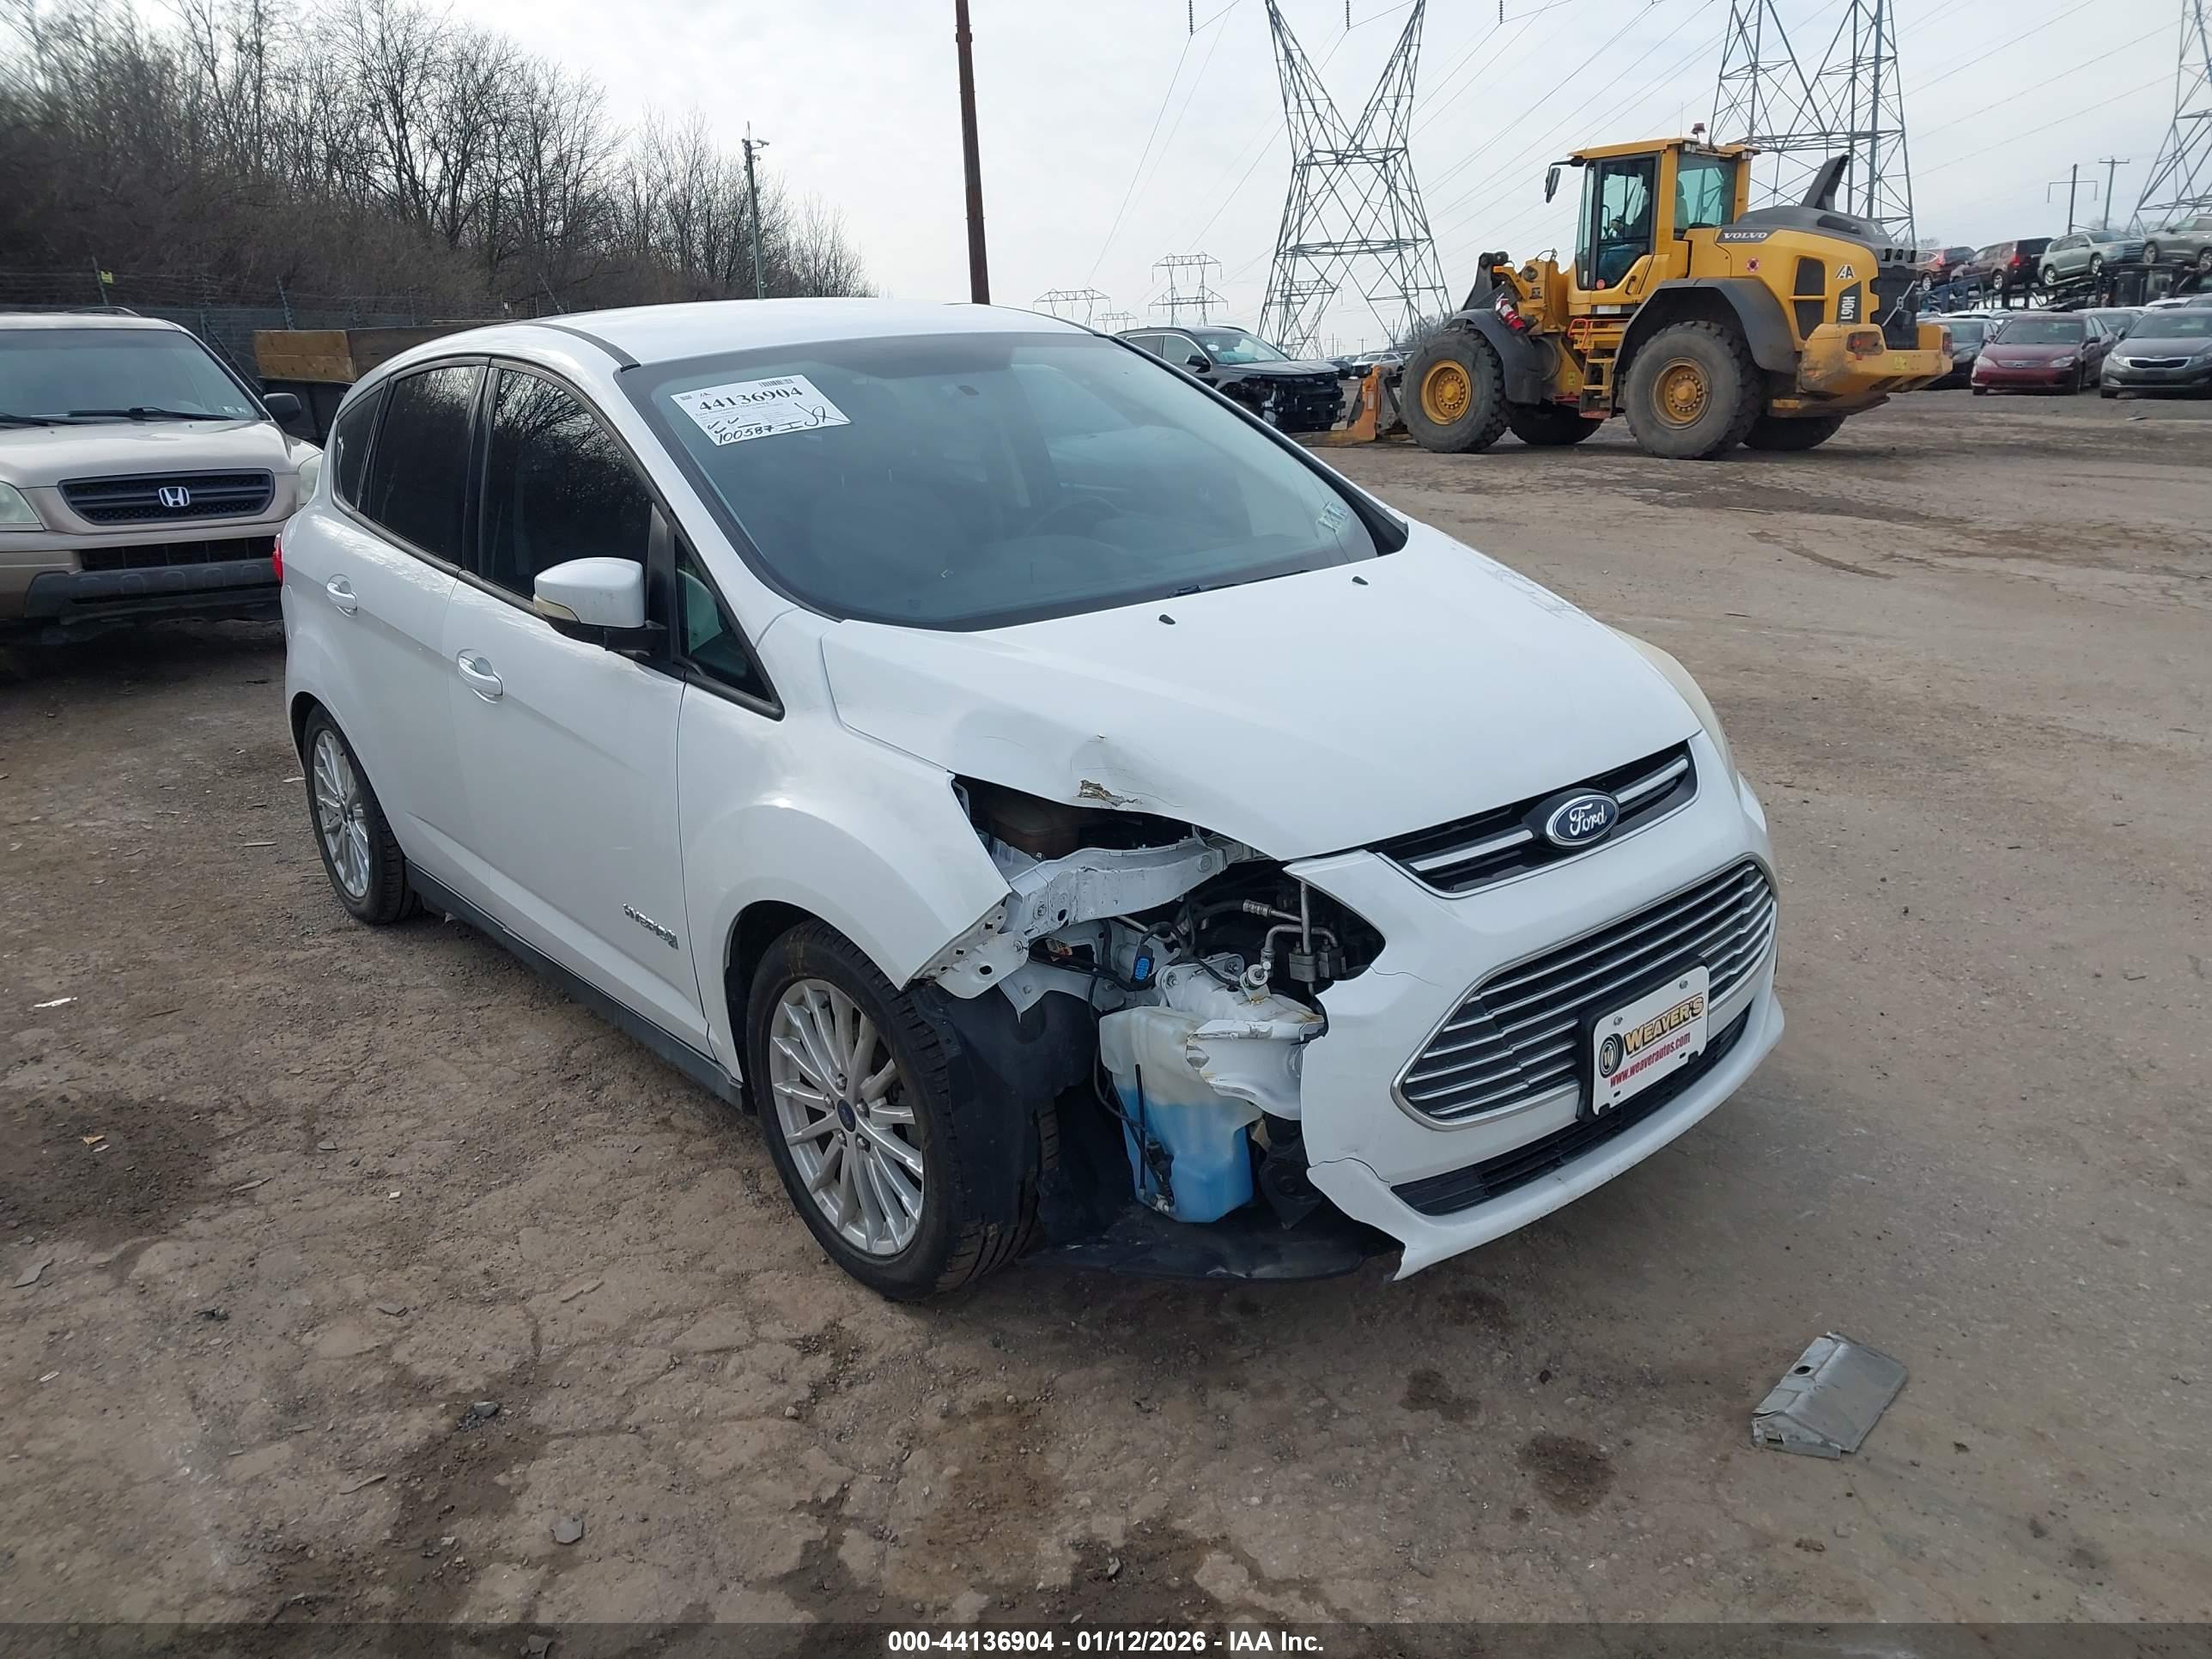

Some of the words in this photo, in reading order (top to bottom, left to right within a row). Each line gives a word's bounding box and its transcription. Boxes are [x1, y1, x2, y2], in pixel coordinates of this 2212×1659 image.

[1840, 295, 1856, 319] L90H
[699, 386, 803, 410] 44136904
[1569, 803, 1607, 836] Ford
[1624, 996, 1705, 1056] WEAVER'S
[1610, 1031, 1691, 1089] www.weaverautos.com
